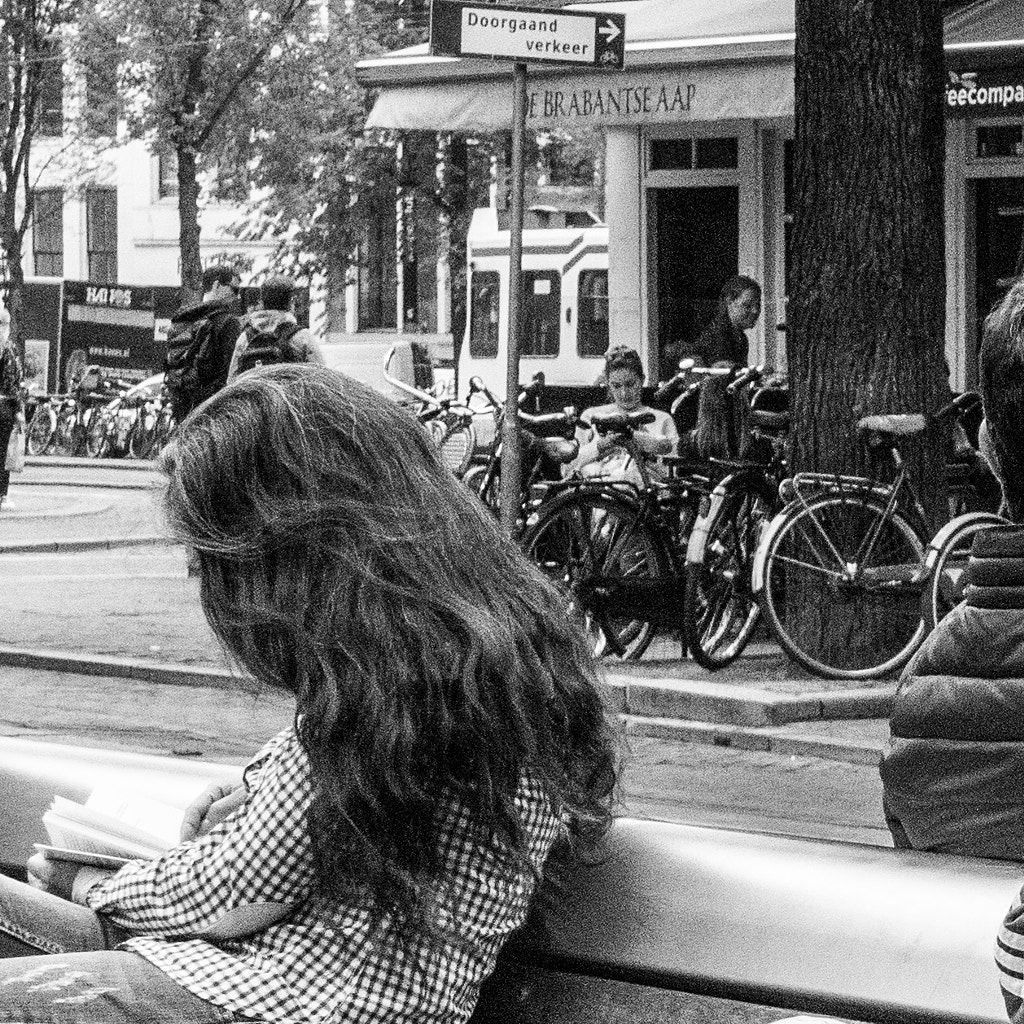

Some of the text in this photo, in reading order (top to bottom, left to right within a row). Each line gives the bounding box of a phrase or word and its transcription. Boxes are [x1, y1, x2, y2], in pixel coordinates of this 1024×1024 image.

[468, 12, 557, 33] Doorgaand
[525, 39, 589, 55] verkeer
[543, 86, 652, 118] BRABANTSE
[655, 83, 696, 113] AAP
